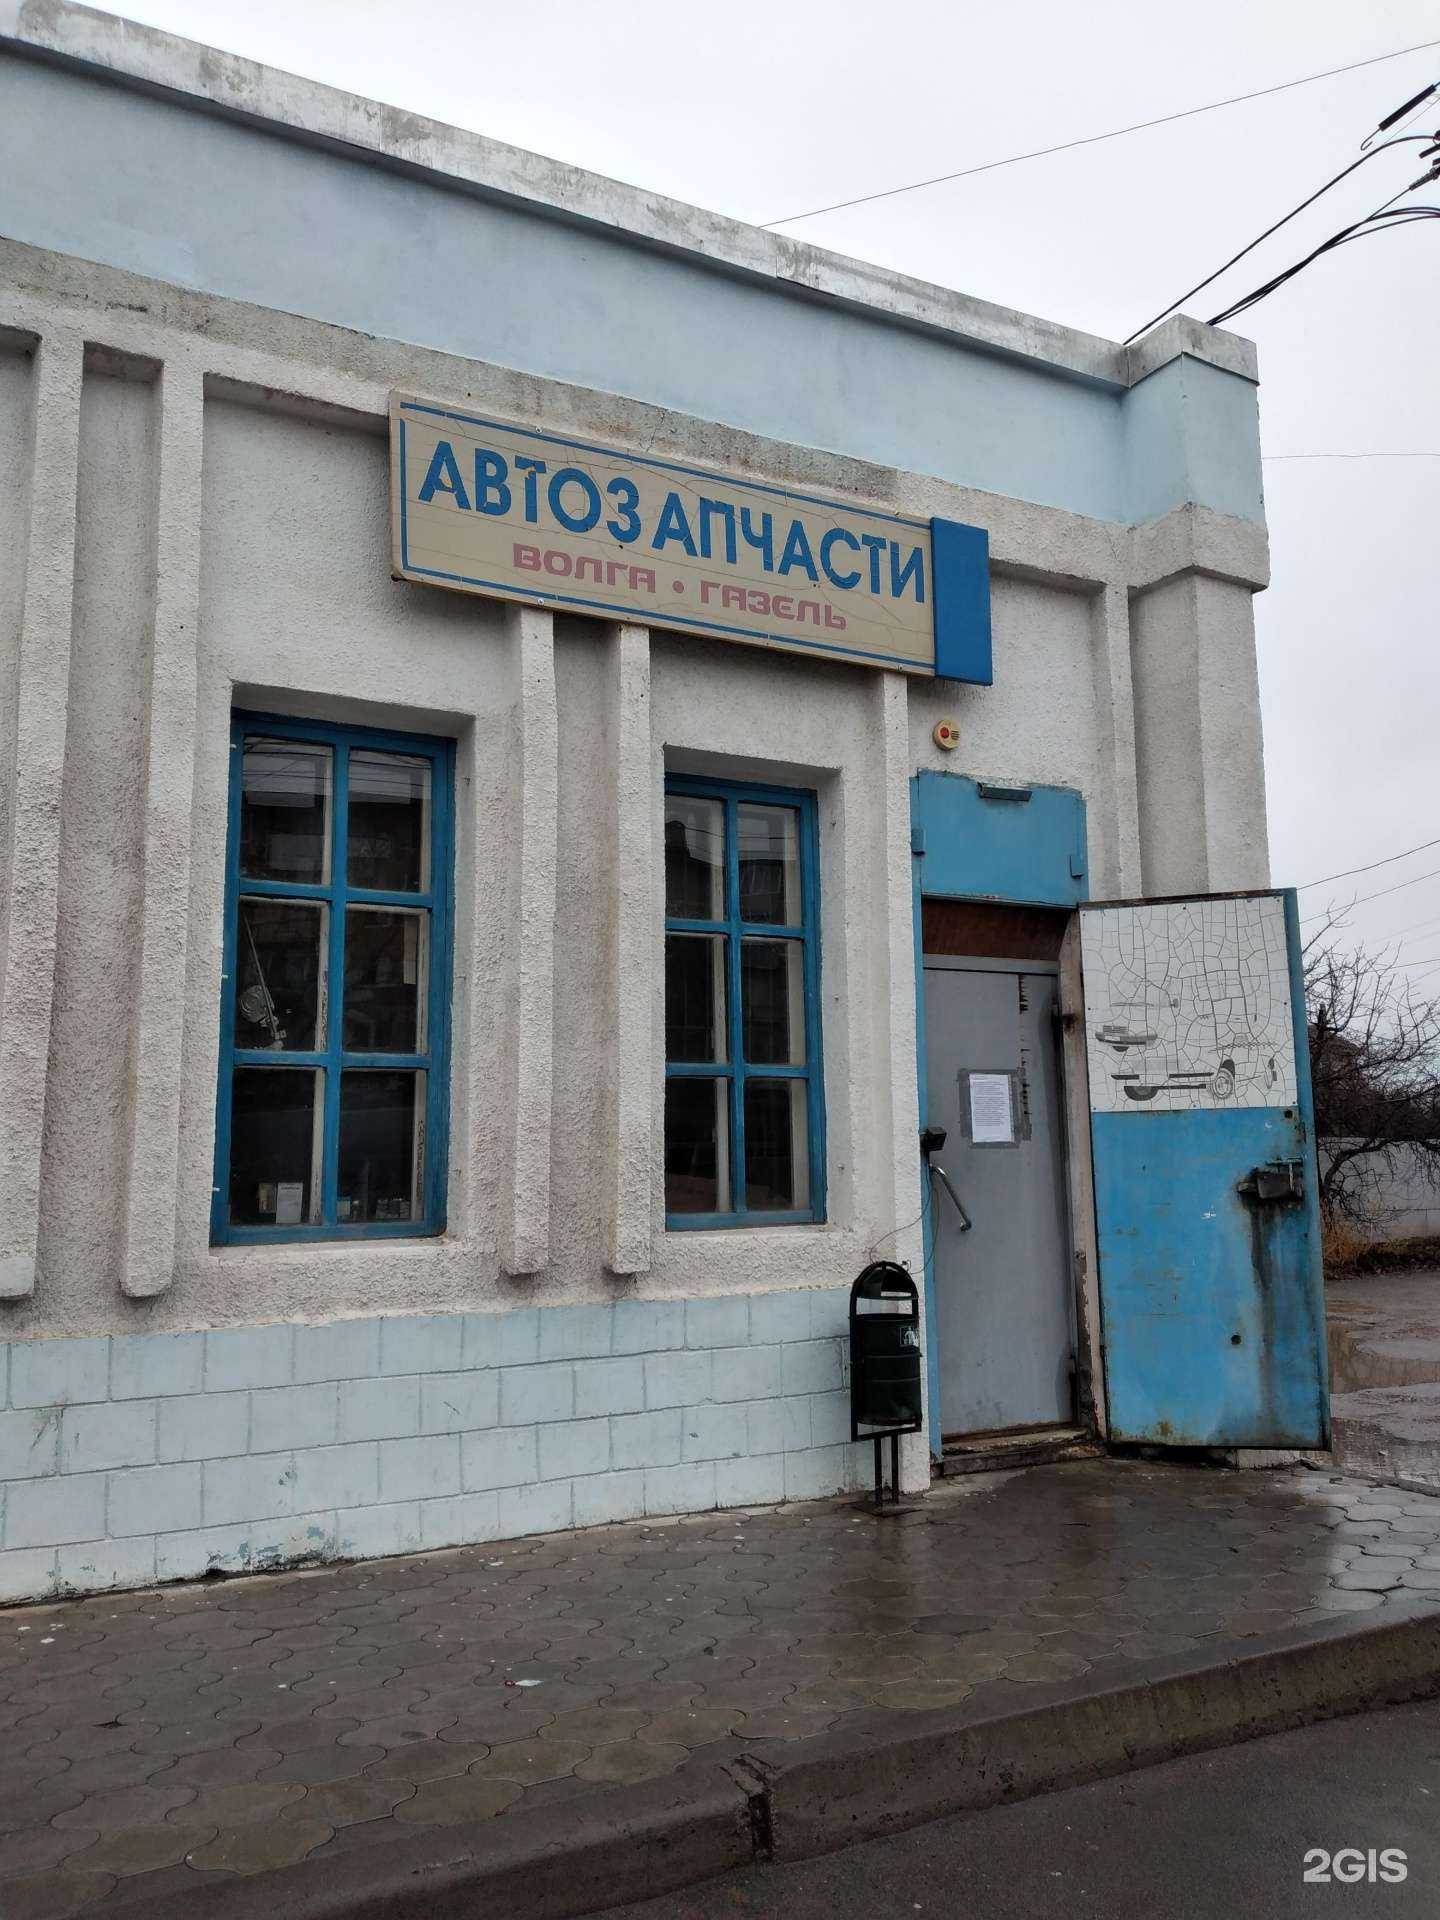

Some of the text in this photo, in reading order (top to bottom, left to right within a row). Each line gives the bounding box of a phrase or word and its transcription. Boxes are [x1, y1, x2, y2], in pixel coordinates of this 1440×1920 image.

[418, 440, 925, 603] АВТОЗАПЧАСТИ
[513, 543, 847, 630] ВОЛГА ГАЗЕЛЬ
